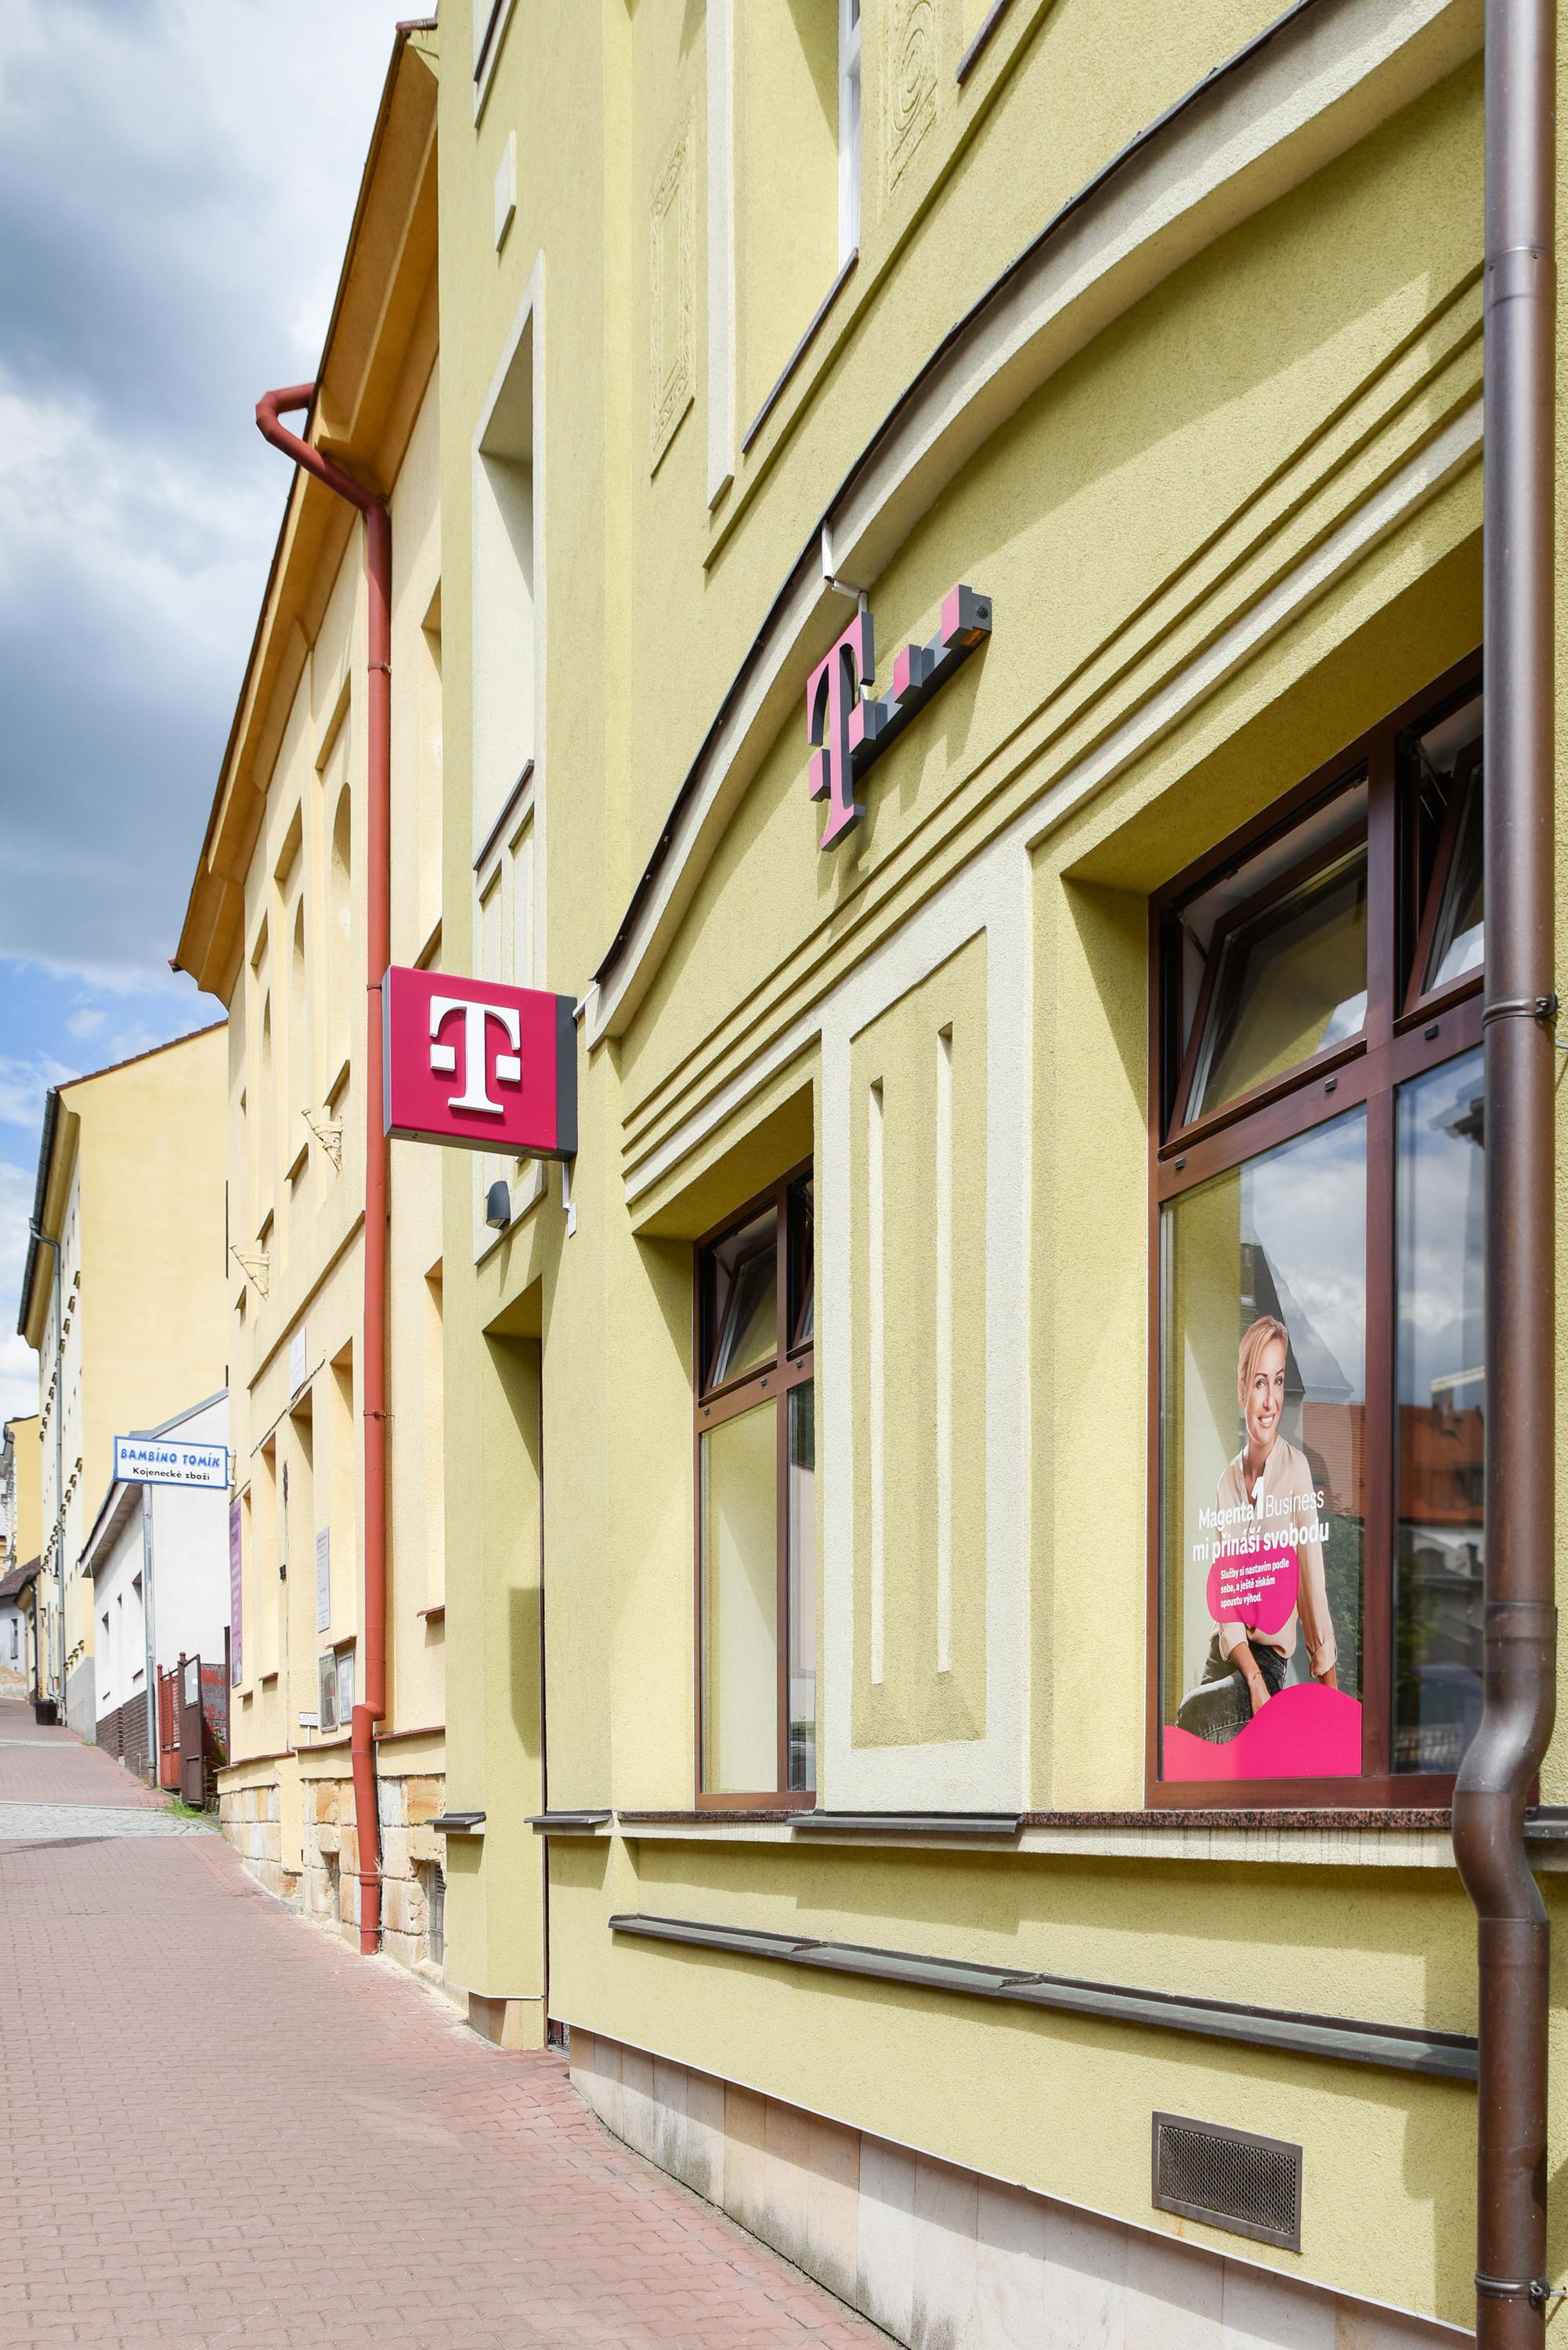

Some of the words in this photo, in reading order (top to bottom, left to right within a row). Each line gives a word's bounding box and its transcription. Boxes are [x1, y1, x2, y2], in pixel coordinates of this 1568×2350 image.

[807, 611, 875, 852] T
[428, 994, 522, 1116] T
[1266, 1490, 1324, 1518] Business
[1192, 1538, 1209, 1562] mi
[1212, 1526, 1261, 1564] přináší
[1263, 1517, 1330, 1552] svobodu
[1220, 1567, 1239, 1579] Služby
[1239, 1566, 1245, 1576] si
[1245, 1561, 1272, 1575] nastavím
[1272, 1557, 1290, 1572] podle
[1220, 1583, 1236, 1593] sebe,
[1240, 1578, 1255, 1593] ještě
[1255, 1574, 1276, 1588] získám
[1220, 1596, 1243, 1610] spoustu
[1243, 1591, 1262, 1606] výhod.
